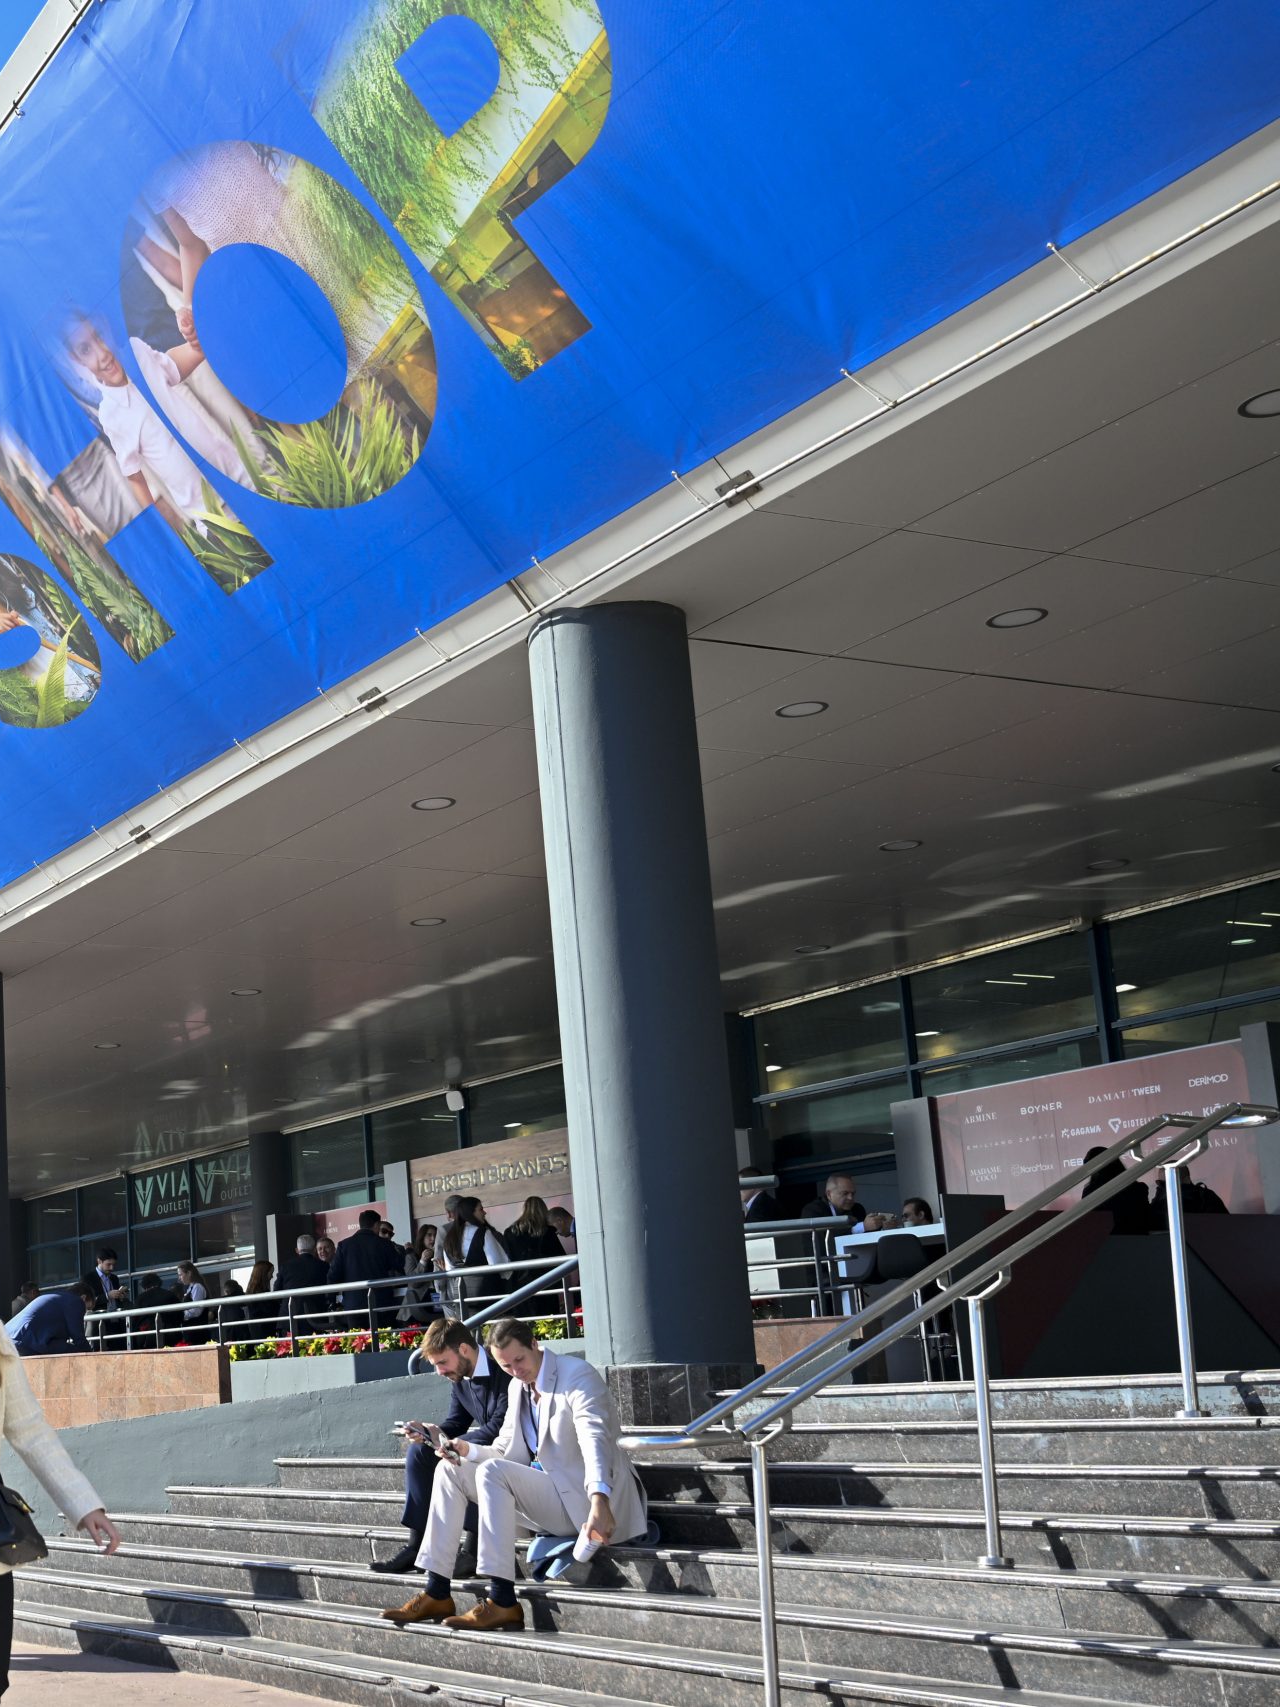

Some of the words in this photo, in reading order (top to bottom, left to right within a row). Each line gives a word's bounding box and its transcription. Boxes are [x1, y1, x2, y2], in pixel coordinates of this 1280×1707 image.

[1087, 1090, 1126, 1104] DAMAT
[1019, 1101, 1063, 1115] BOYNER
[964, 1112, 998, 1125] ARMINE
[1070, 1125, 1102, 1137] GAGAWA
[415, 1168, 486, 1198] TURKISH
[488, 1152, 569, 1184] BRANDS
[969, 1165, 1002, 1177] MADAME
[156, 1169, 190, 1199] VIA
[975, 1174, 998, 1183] COCO
